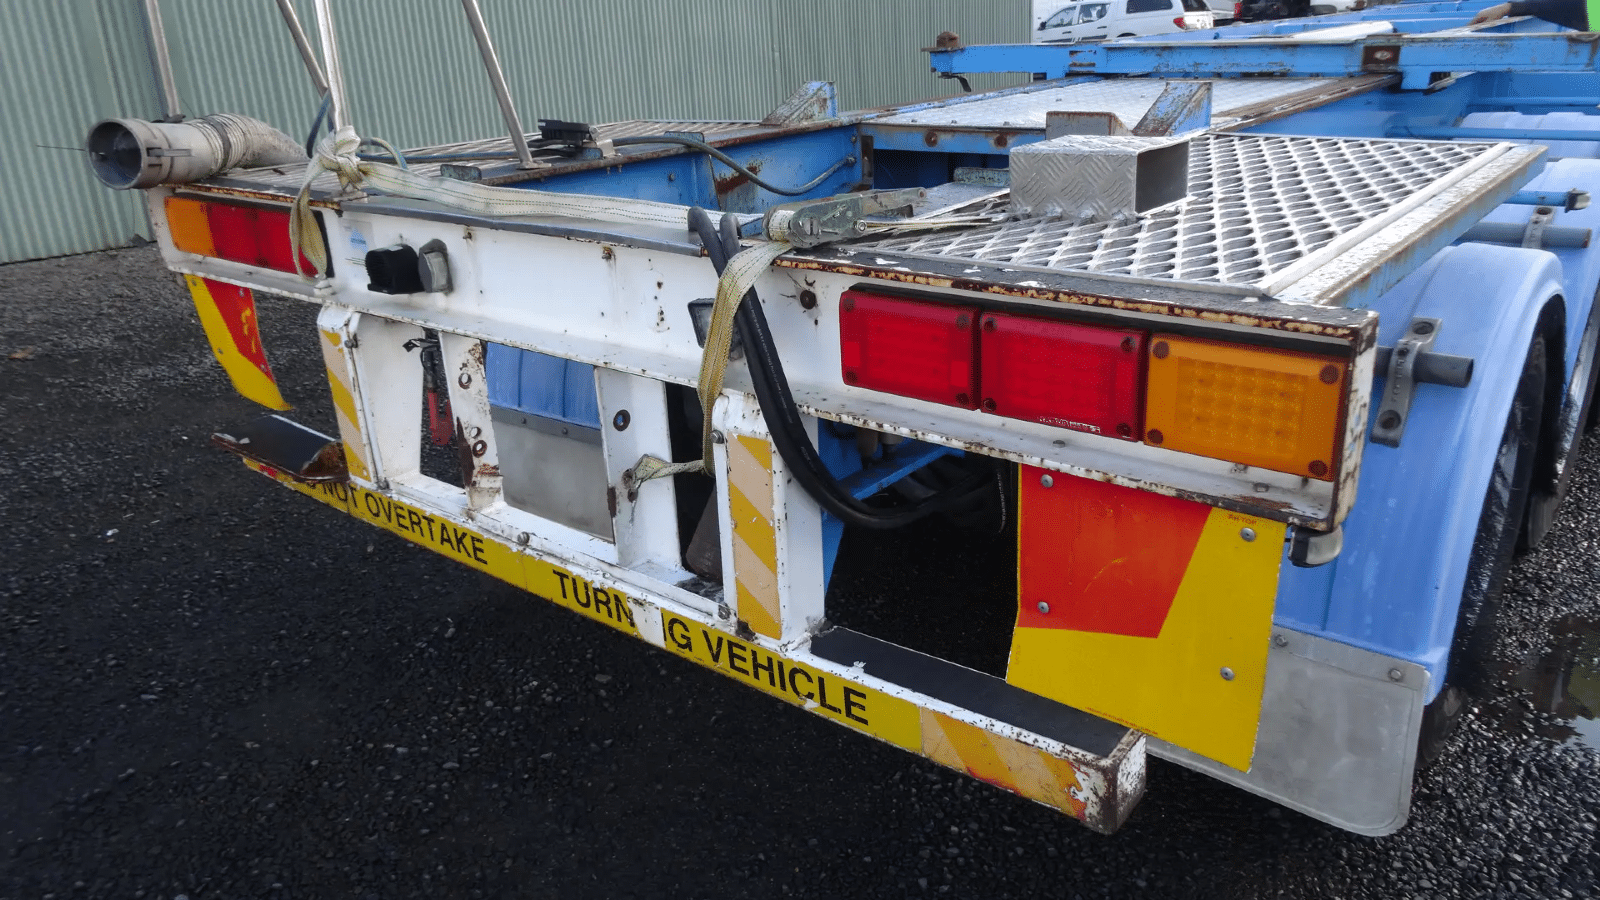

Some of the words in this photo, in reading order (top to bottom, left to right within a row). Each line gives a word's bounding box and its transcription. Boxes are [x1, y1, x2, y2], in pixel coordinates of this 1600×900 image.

[322, 482, 357, 509] NOT
[366, 492, 488, 565] OVERTAKE
[702, 629, 869, 726] VEHICLE
